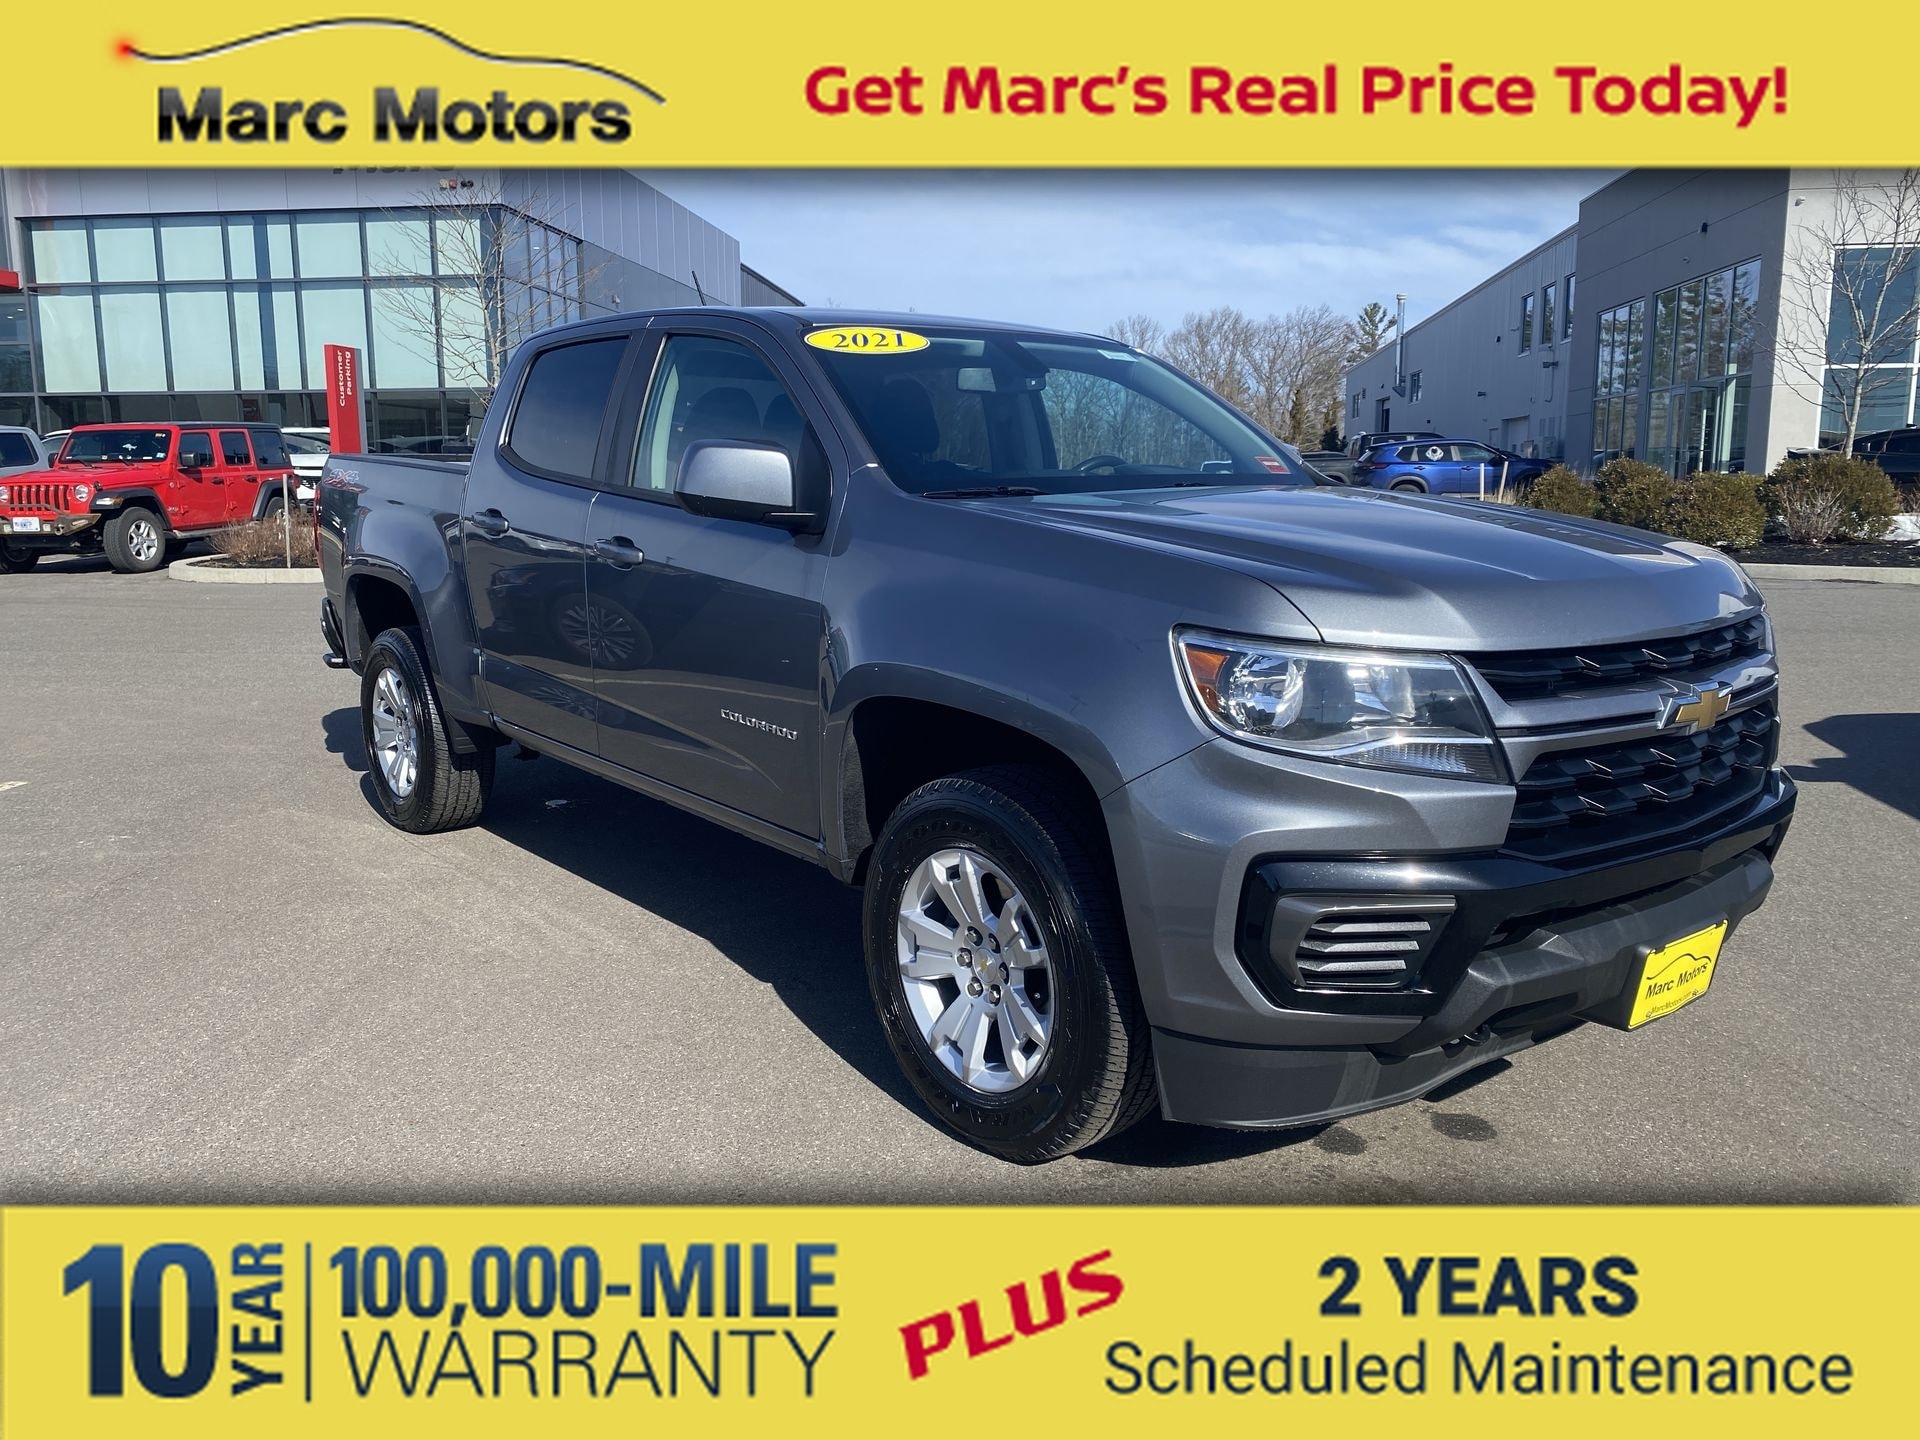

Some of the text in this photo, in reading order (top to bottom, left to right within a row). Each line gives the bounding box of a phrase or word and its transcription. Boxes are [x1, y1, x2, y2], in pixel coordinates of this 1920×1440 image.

[831, 332, 906, 348] 2021
[337, 350, 345, 407] Customer
[721, 708, 798, 740] COLORADO
[1645, 962, 1708, 1000] Marc Motors
